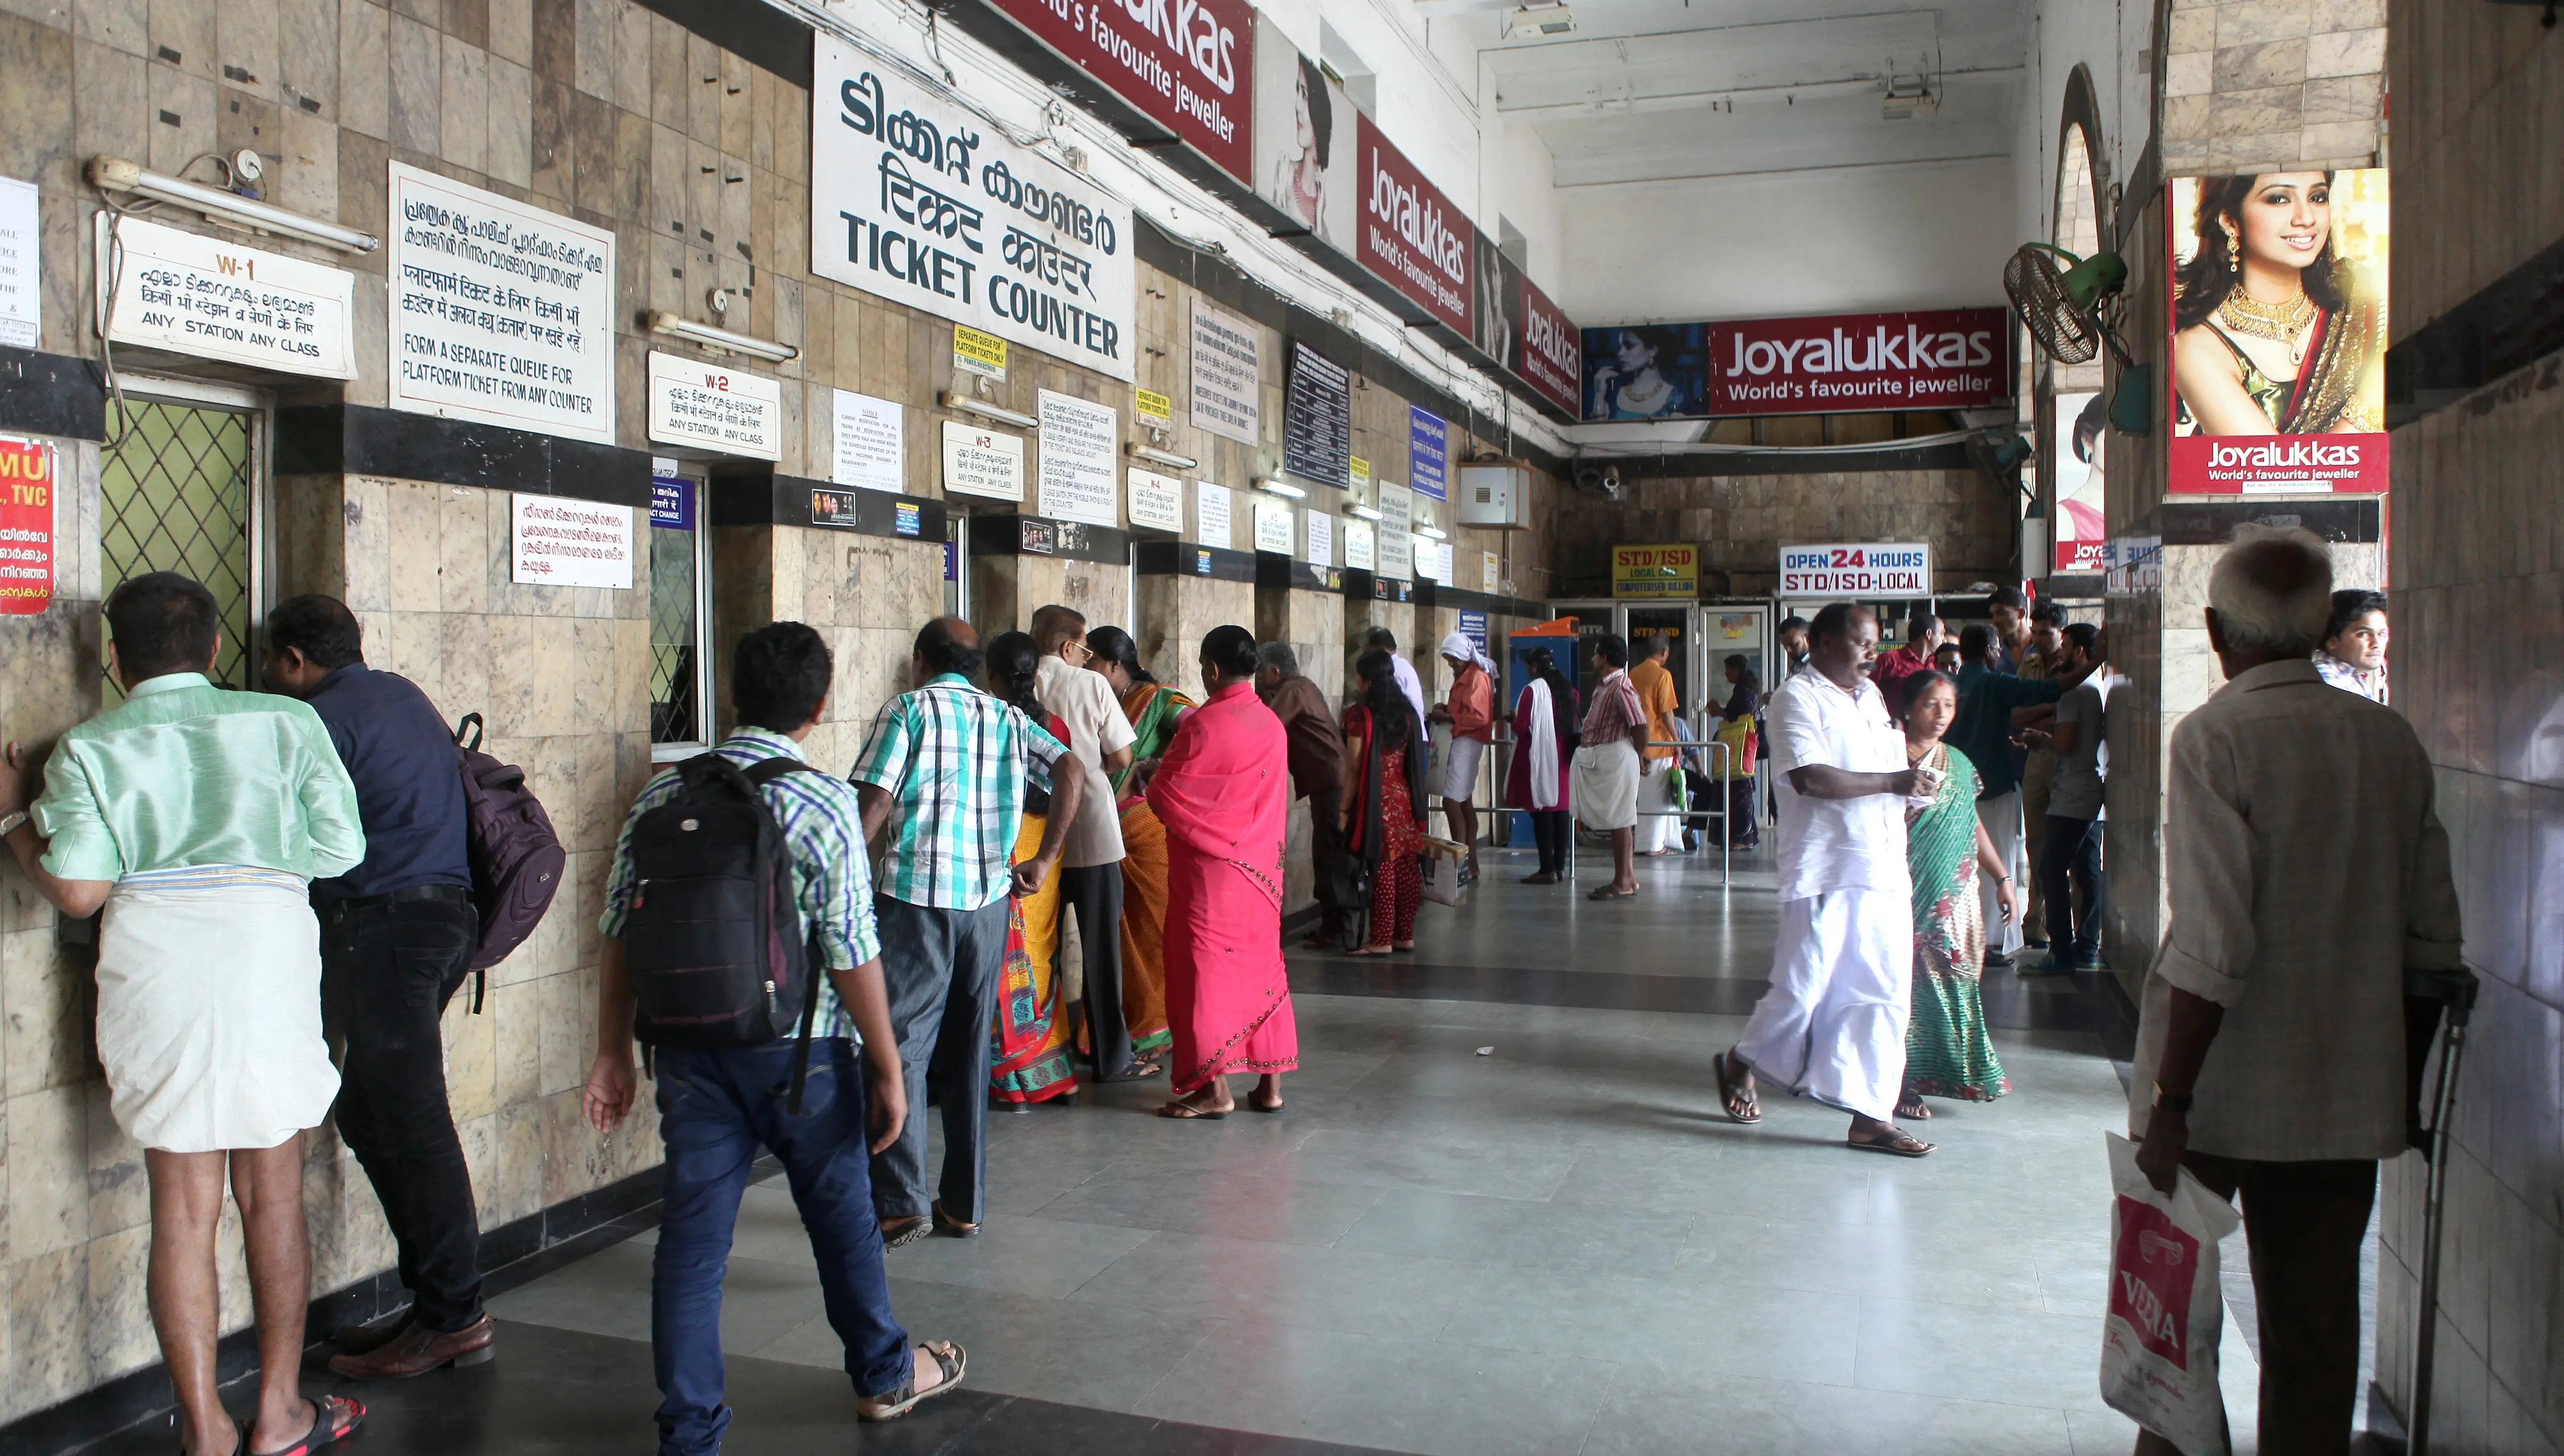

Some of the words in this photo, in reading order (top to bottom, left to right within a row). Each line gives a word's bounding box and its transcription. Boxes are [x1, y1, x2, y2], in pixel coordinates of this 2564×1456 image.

[1090, 5, 1172, 97] favourite
[1175, 70, 1234, 144] jeweller
[878, 151, 984, 254] टिकट
[1001, 224, 1097, 303] काउंटर
[1369, 147, 1464, 285] Joyalukkas
[216, 254, 254, 281] W-1
[1370, 224, 1403, 270] World's
[1404, 254, 1436, 297] favourite
[1438, 278, 1464, 318] jeweller
[840, 210, 976, 305] TICKET
[988, 274, 1119, 360] COUNTER
[141, 285, 172, 306] किसी
[178, 294, 192, 311] भी
[196, 297, 230, 319] स्टेशन
[235, 309, 246, 322] व
[277, 313, 291, 331] के
[295, 320, 314, 336] लिए
[459, 276, 491, 304] टिकट
[494, 285, 506, 308] के
[508, 289, 531, 315] लिए
[535, 297, 563, 323] किसी
[566, 306, 580, 327] भी
[437, 297, 447, 320] में
[449, 304, 476, 327] अलग
[529, 324, 544, 343] पर
[142, 312, 175, 328] ANY
[185, 320, 244, 342] STATION
[249, 333, 276, 348] ANY
[281, 339, 320, 357] CLASS
[958, 329, 978, 343] SEPARATE
[979, 336, 992, 349] QUEUE
[1526, 294, 1577, 381] Joyalukkas
[404, 333, 437, 357] FORM
[440, 342, 448, 359] A
[451, 344, 506, 372] SEPARATE
[510, 357, 548, 381] QUEUE
[552, 367, 572, 385] FOR
[956, 340, 977, 354] PLATFORM
[978, 347, 994, 360] TICKETS
[994, 352, 1004, 364] ONLY
[1727, 324, 1992, 376] Joyalukkas
[705, 374, 729, 392] W-2
[1527, 352, 1544, 377] World's
[1544, 363, 1561, 392] favourite
[403, 360, 462, 388] PLATFORM
[463, 372, 499, 395] TICKET
[501, 380, 527, 401] FROM
[528, 386, 547, 407] ANY
[549, 391, 592, 415] COUNTER
[1728, 380, 1804, 401] World's
[1809, 378, 1901, 397] favourite
[1908, 376, 1992, 399] jeweller
[669, 418, 687, 430] ANY
[687, 422, 719, 436] STATION
[724, 429, 738, 440] ANY
[740, 432, 763, 445] CLASS
[976, 435, 991, 449] W-3
[2208, 441, 2360, 467] Joyalukkas
[958, 472, 967, 481] ANY
[967, 474, 984, 484] STATION
[988, 478, 997, 486] ANY
[997, 479, 1011, 488] CLASS
[2209, 470, 2252, 480] World's
[2255, 469, 2308, 480] favourite
[2311, 468, 2360, 481] jeweller
[11, 484, 47, 508] TVC
[658, 511, 679, 520] CHANGE
[1619, 550, 1691, 566] STD/ISD
[1786, 554, 1828, 569] OPEN
[1831, 549, 1865, 568] 24
[1869, 552, 1923, 567] HOURS
[1630, 568, 1655, 577] LOCAL
[1617, 583, 1665, 592] COMPUTERISED
[1669, 582, 1694, 591] BILLING
